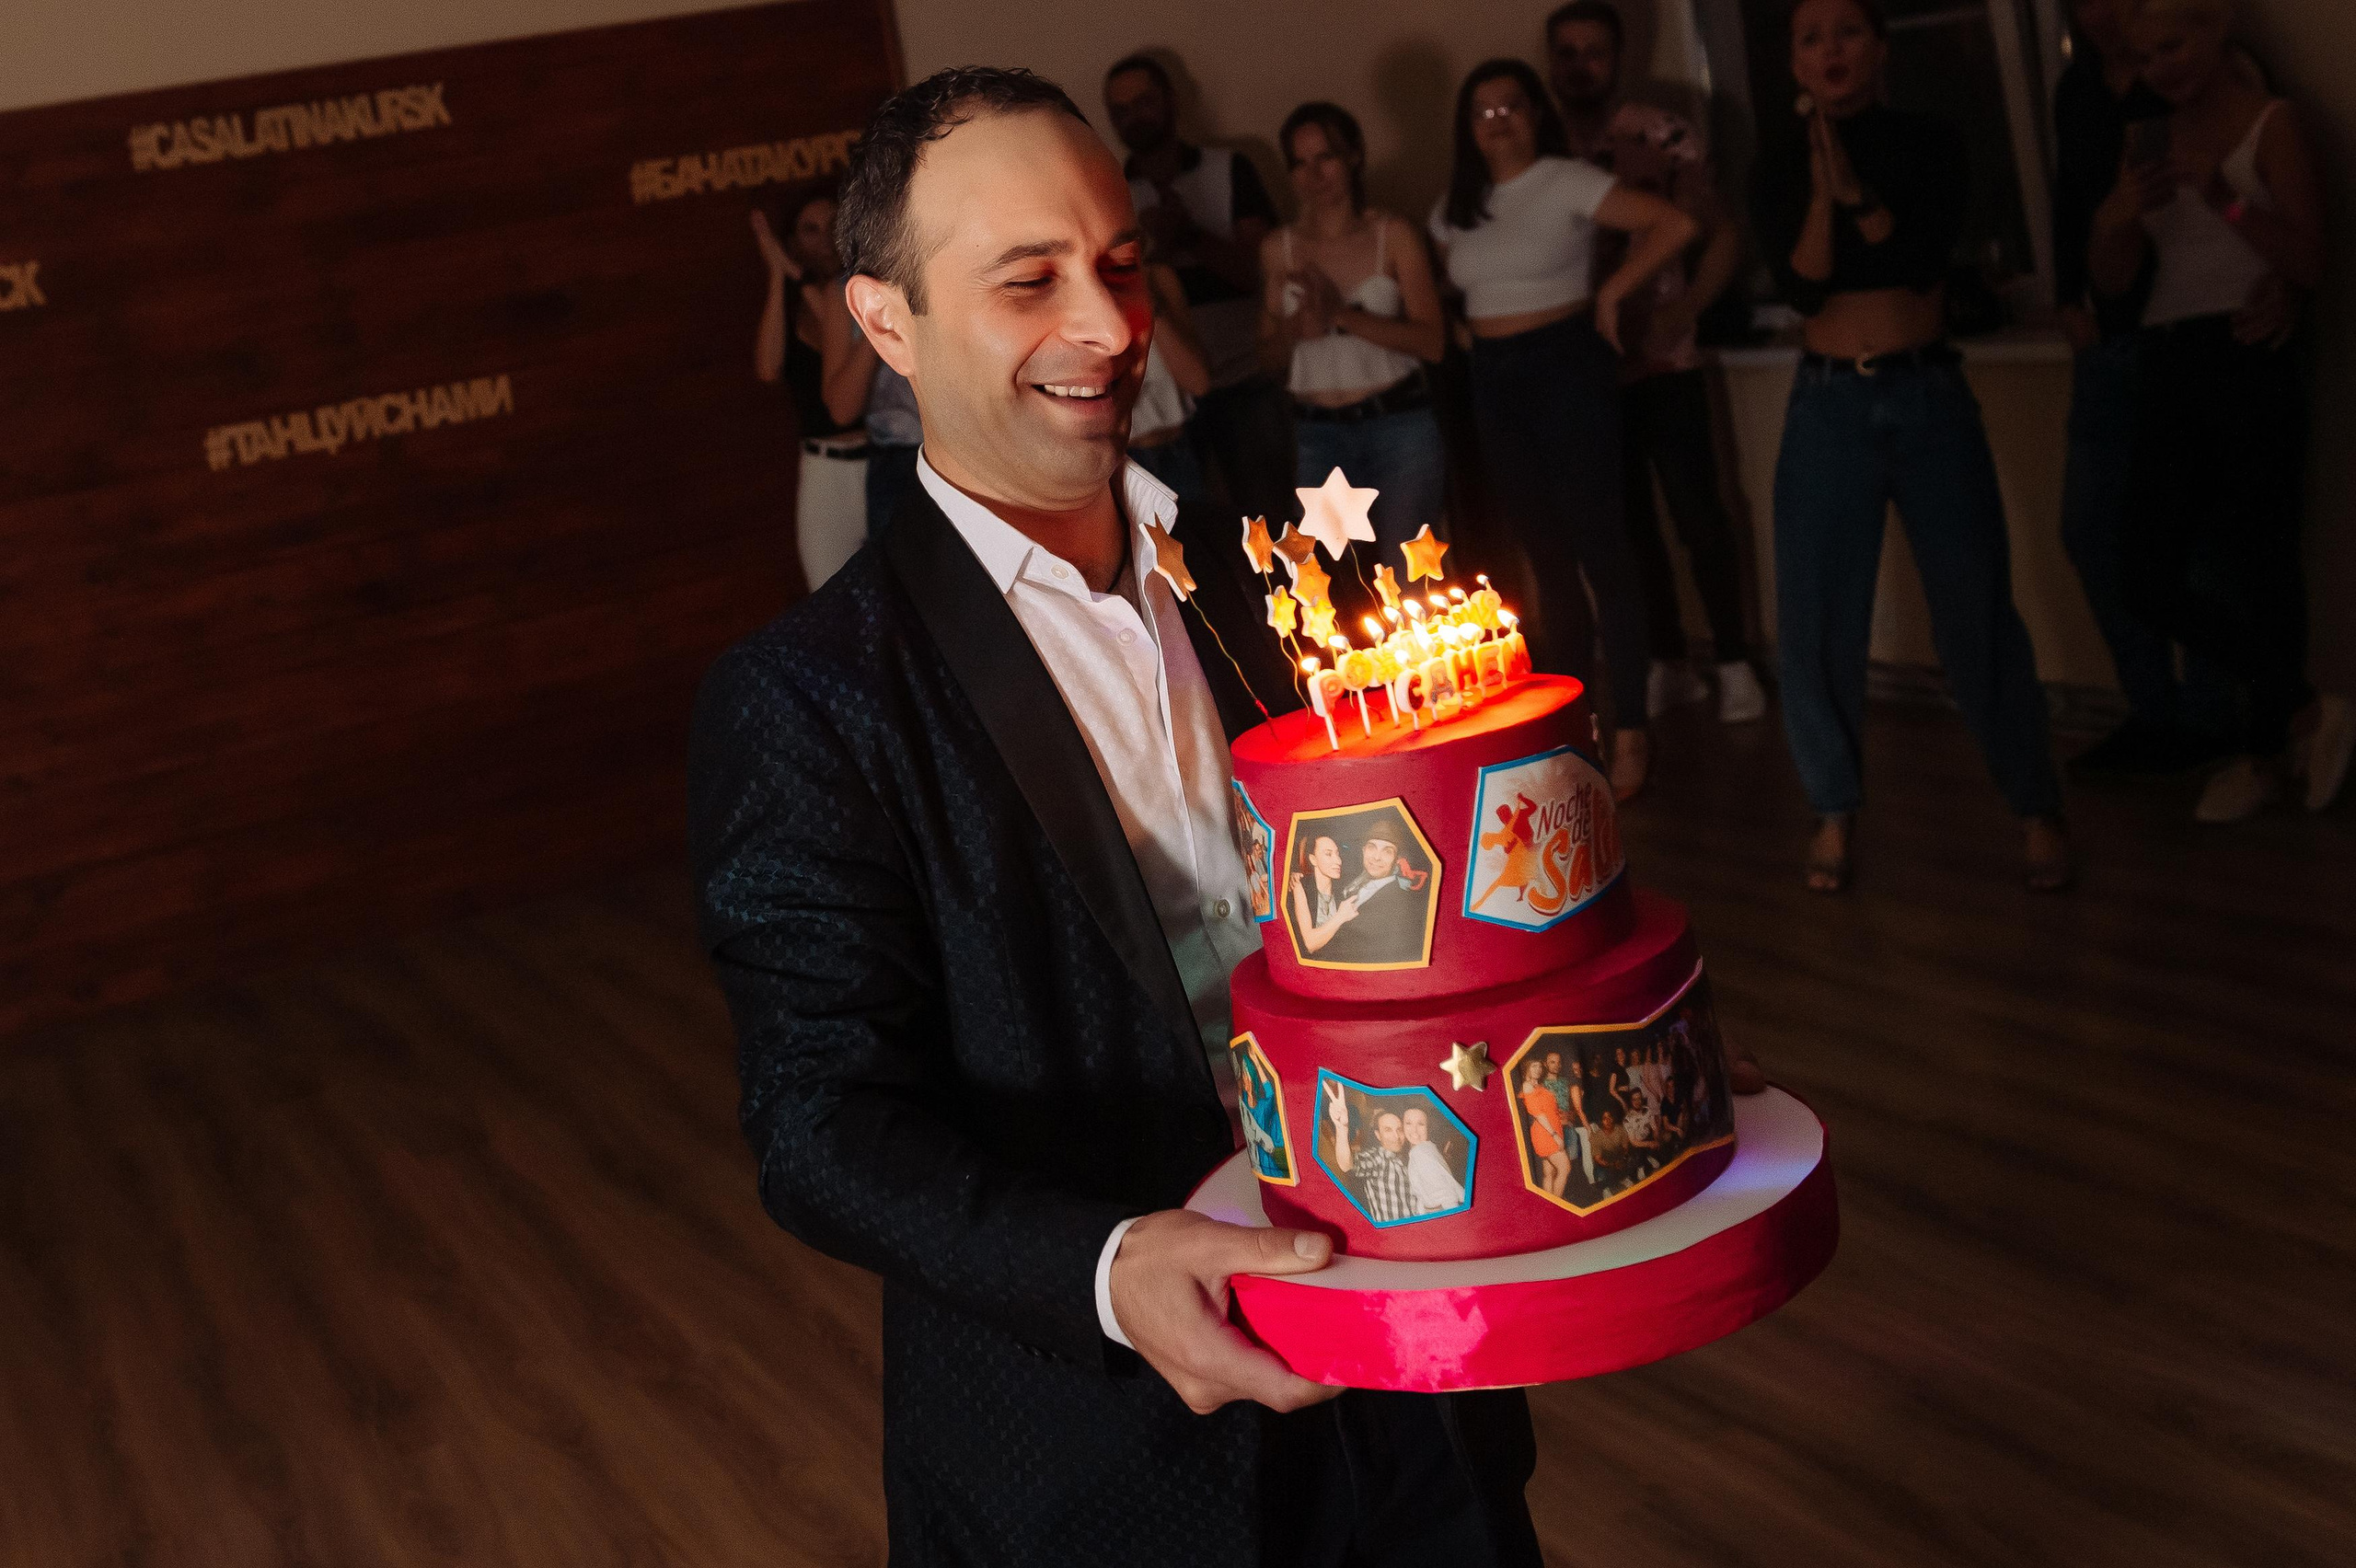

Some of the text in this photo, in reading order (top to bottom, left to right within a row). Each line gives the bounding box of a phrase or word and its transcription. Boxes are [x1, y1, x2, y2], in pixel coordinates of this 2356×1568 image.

[129, 83, 452, 171] #CASALATINAKURSK
[204, 374, 514, 471] #ТАНЦУЙСНАМИ
[1528, 786, 1623, 917] Sal
[1536, 782, 1591, 840] Noche
[1572, 809, 1591, 844] de
